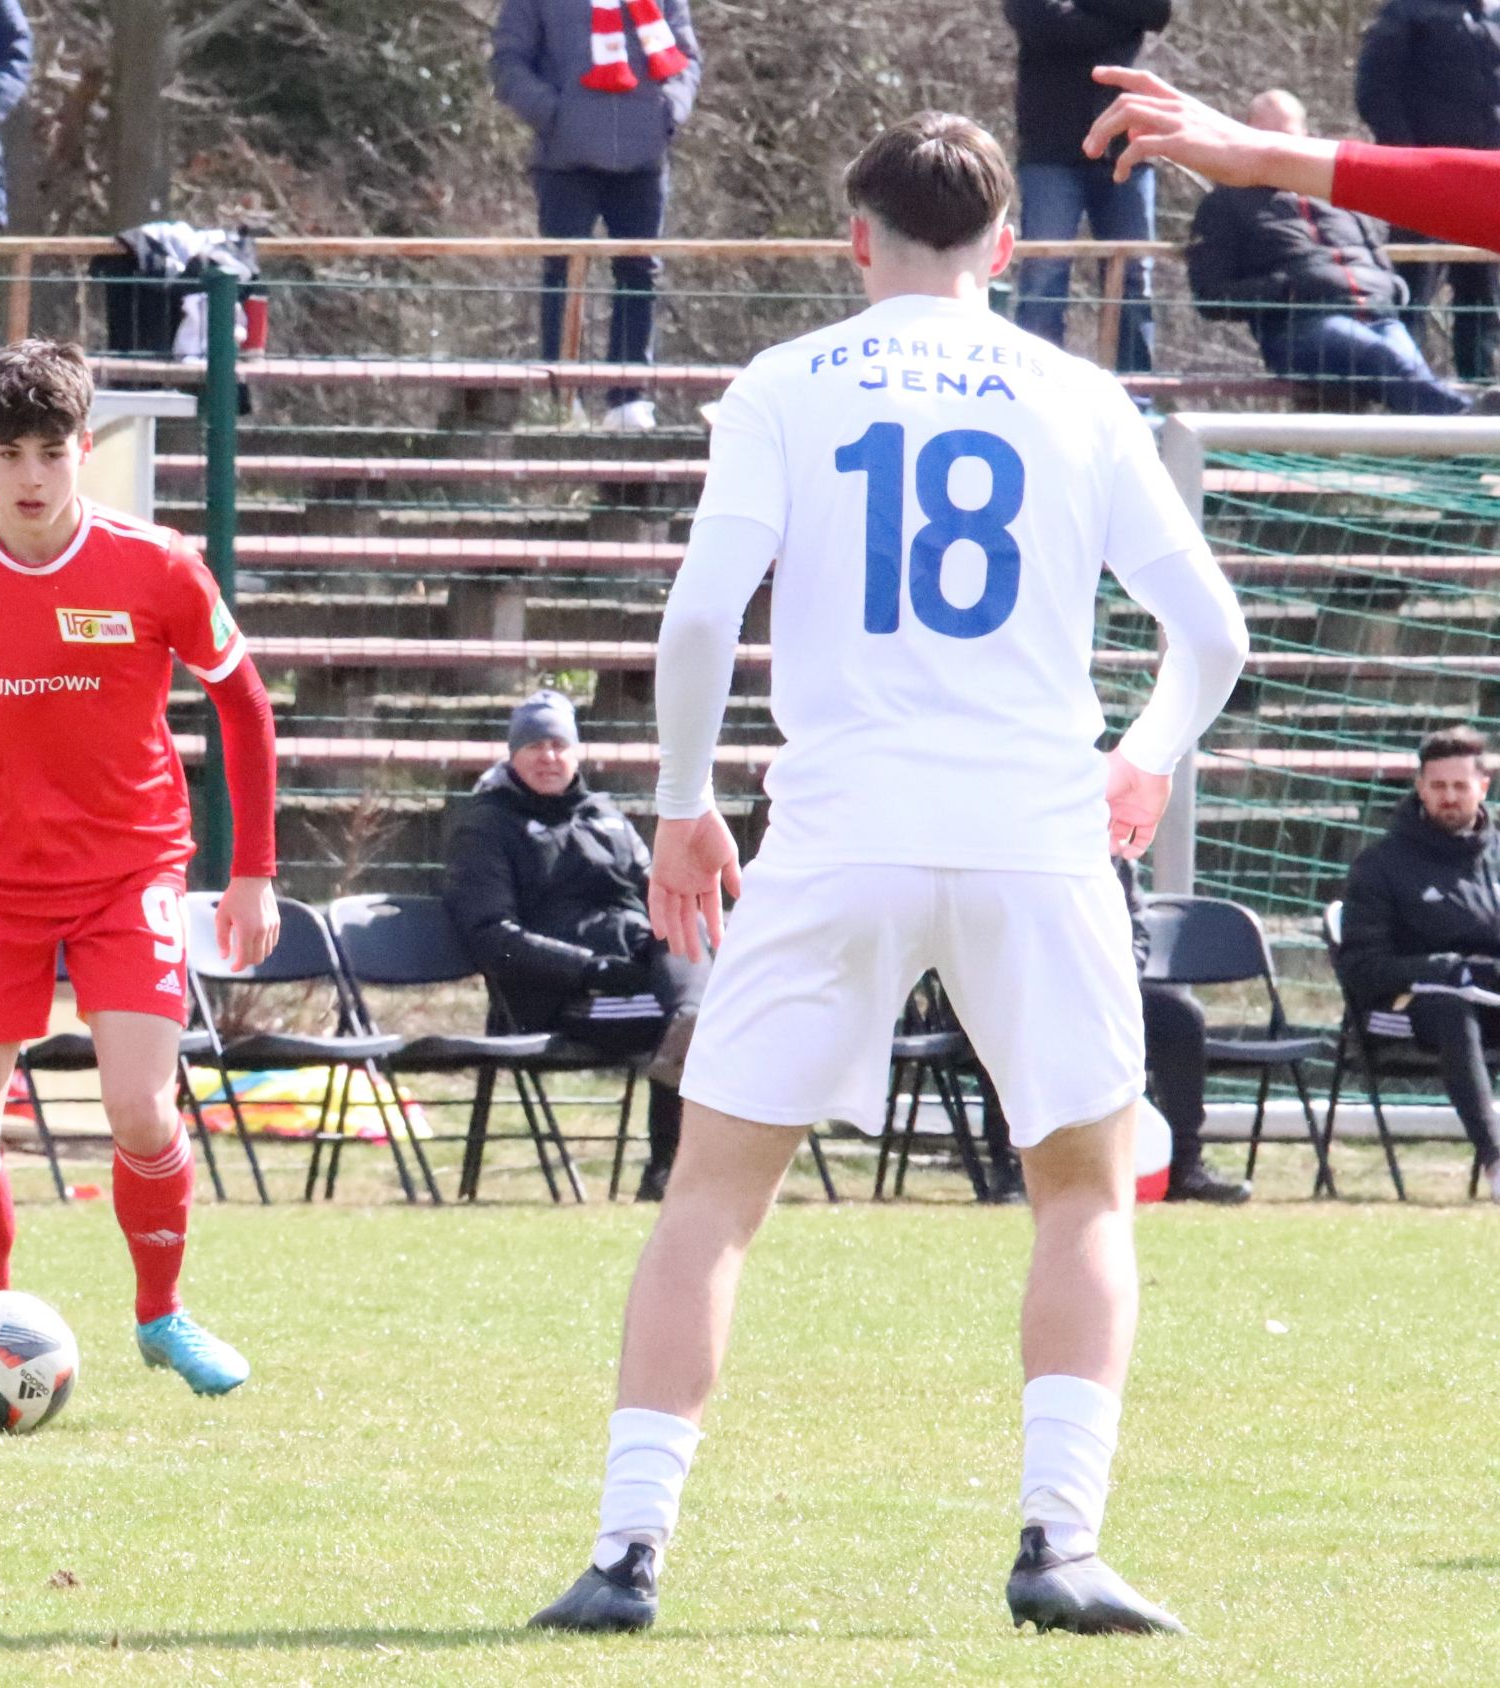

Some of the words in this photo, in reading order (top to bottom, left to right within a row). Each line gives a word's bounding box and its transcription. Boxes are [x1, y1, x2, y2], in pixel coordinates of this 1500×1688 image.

[811, 346, 849, 375] FC
[862, 337, 952, 360] CARL
[966, 344, 1056, 382] ZEIS
[859, 365, 1016, 401] JENA
[834, 421, 1026, 640] 18
[100, 623, 128, 636] UNION
[141, 885, 182, 964] 9
[20, 1368, 50, 1396] adidas
